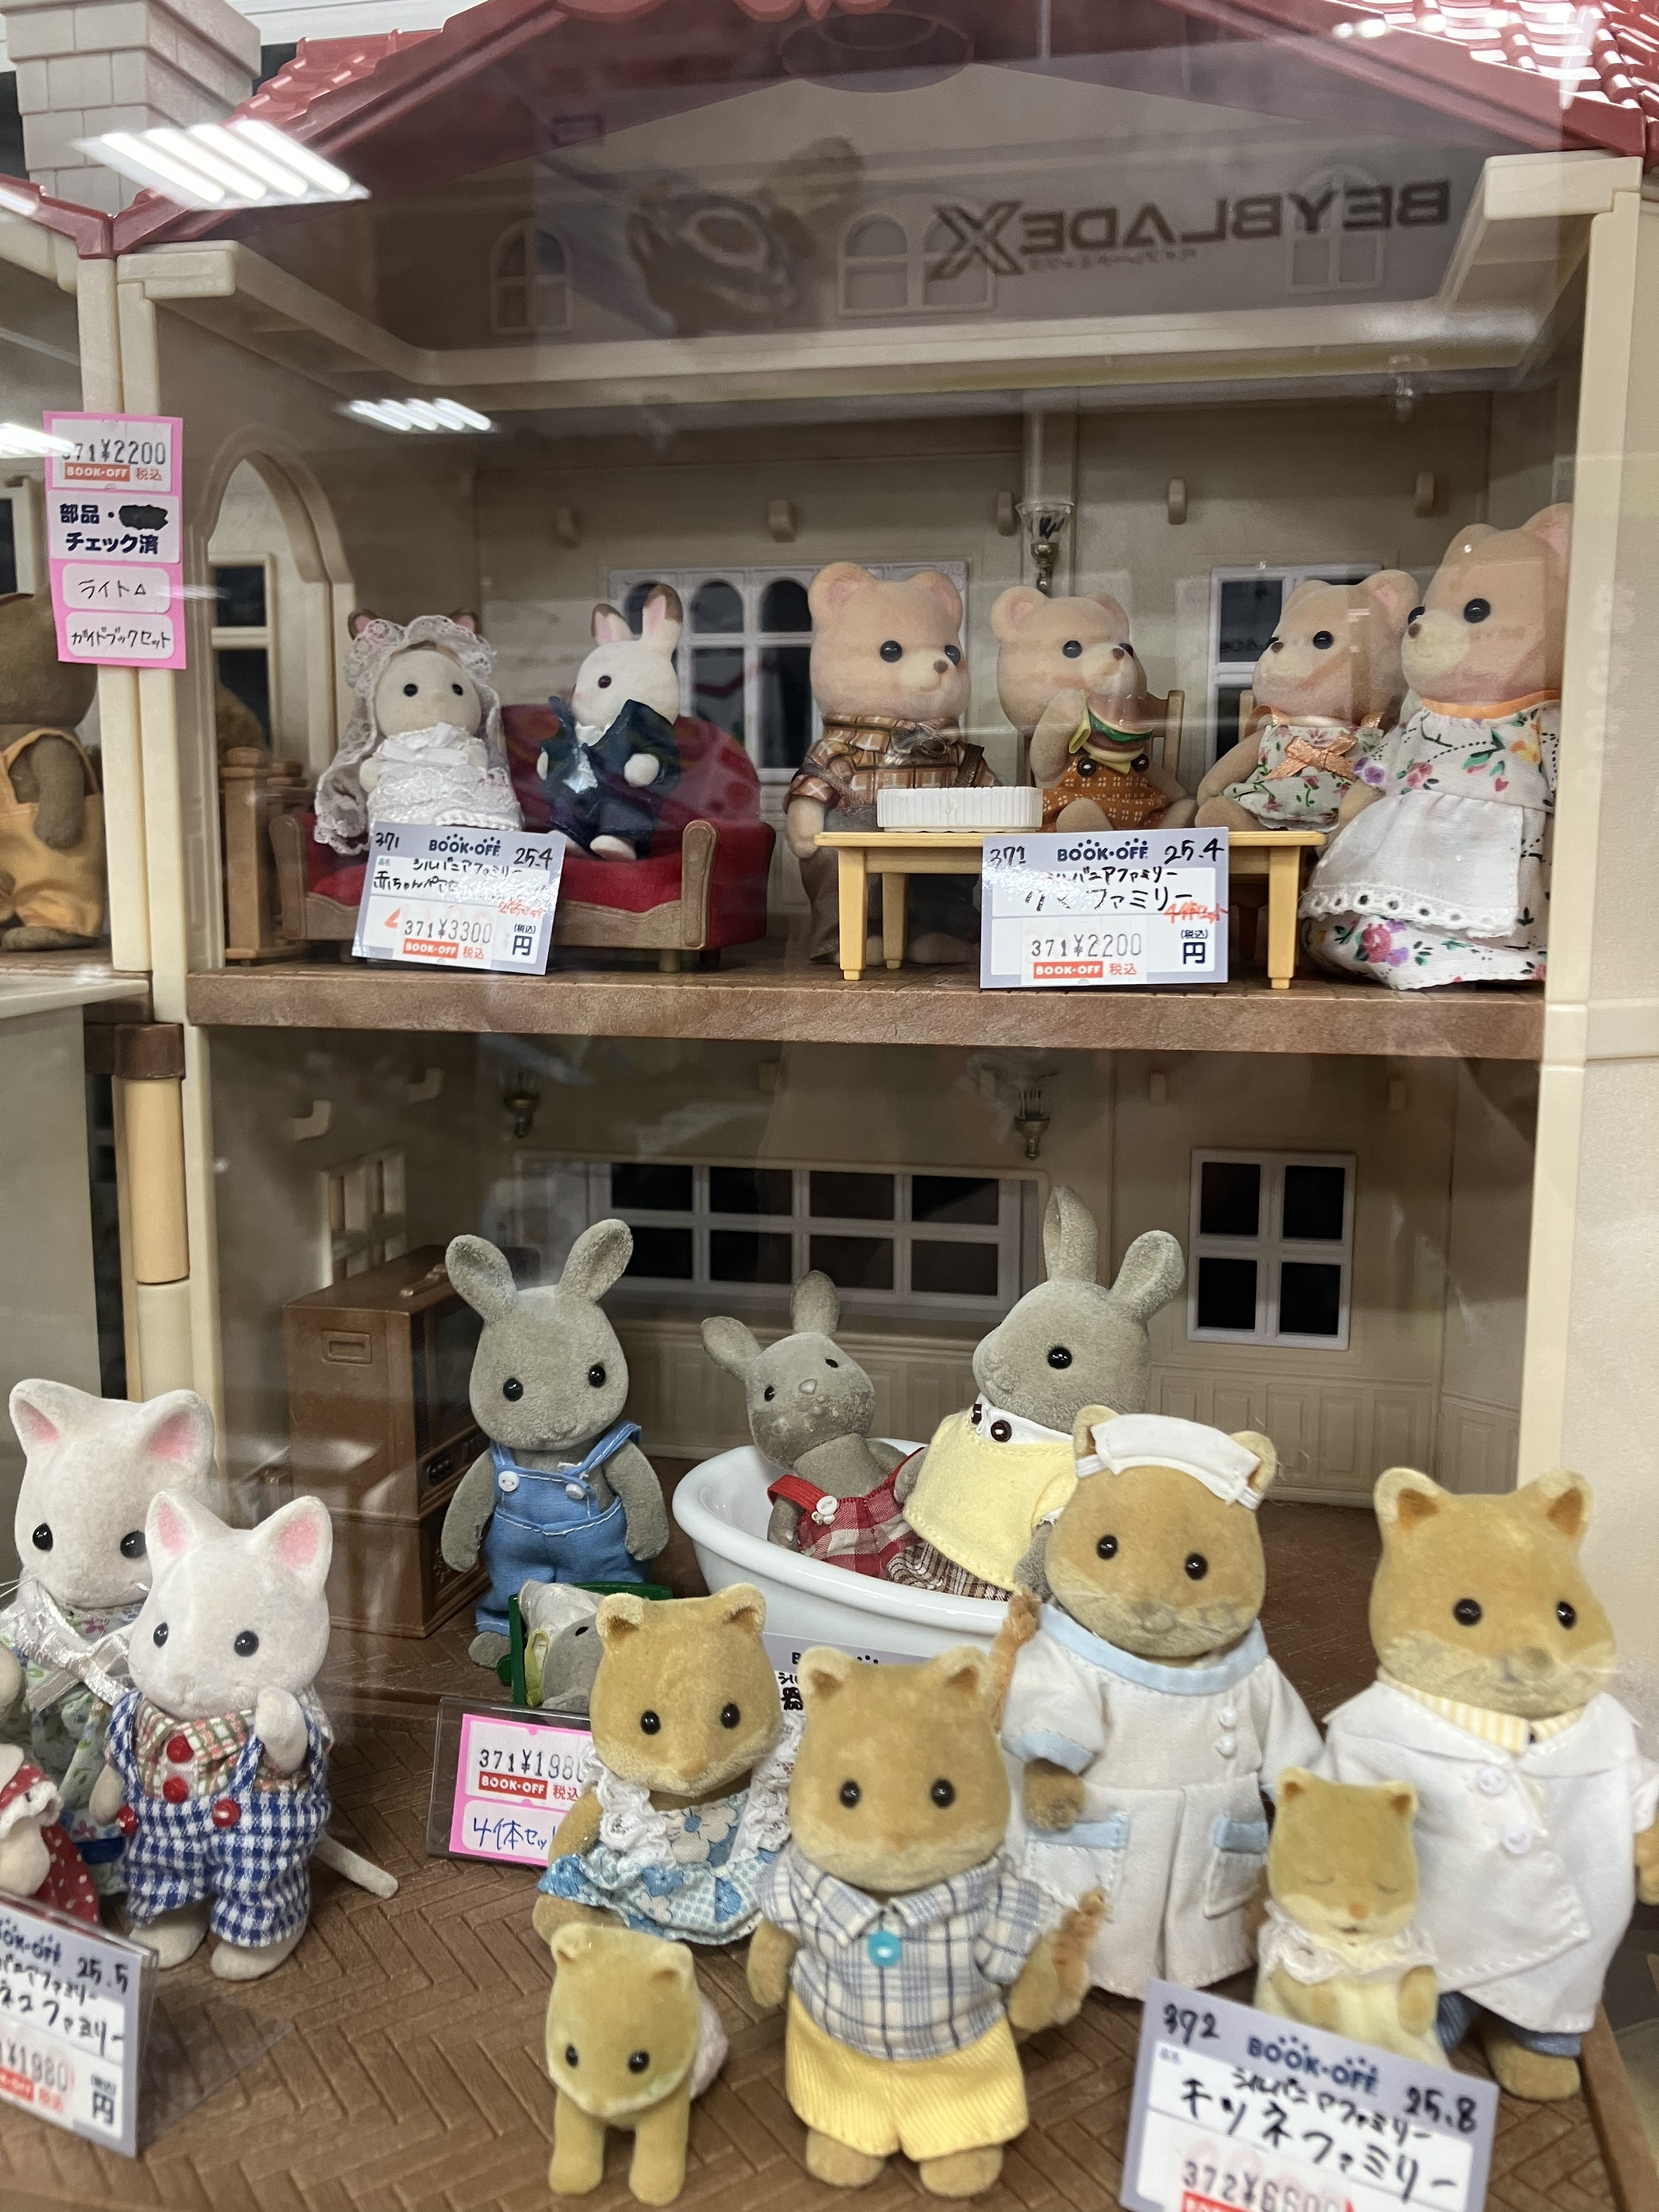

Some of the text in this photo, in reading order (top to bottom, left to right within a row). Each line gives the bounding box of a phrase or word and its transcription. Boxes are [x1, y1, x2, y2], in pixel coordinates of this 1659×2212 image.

[136, 468, 162, 481] 税込
[65, 532, 159, 555] チェック済
[375, 832, 399, 851] 371
[1164, 838, 1224, 865] 25.4
[514, 848, 553, 871] 25.4
[990, 846, 1028, 867] 371
[462, 946, 484, 960] 税込
[512, 935, 533, 956] 円
[1183, 942, 1206, 965] 円
[1109, 963, 1137, 976] 税込
[77, 1957, 128, 1994] 25.5
[1405, 2086, 1477, 2133] 25.8
